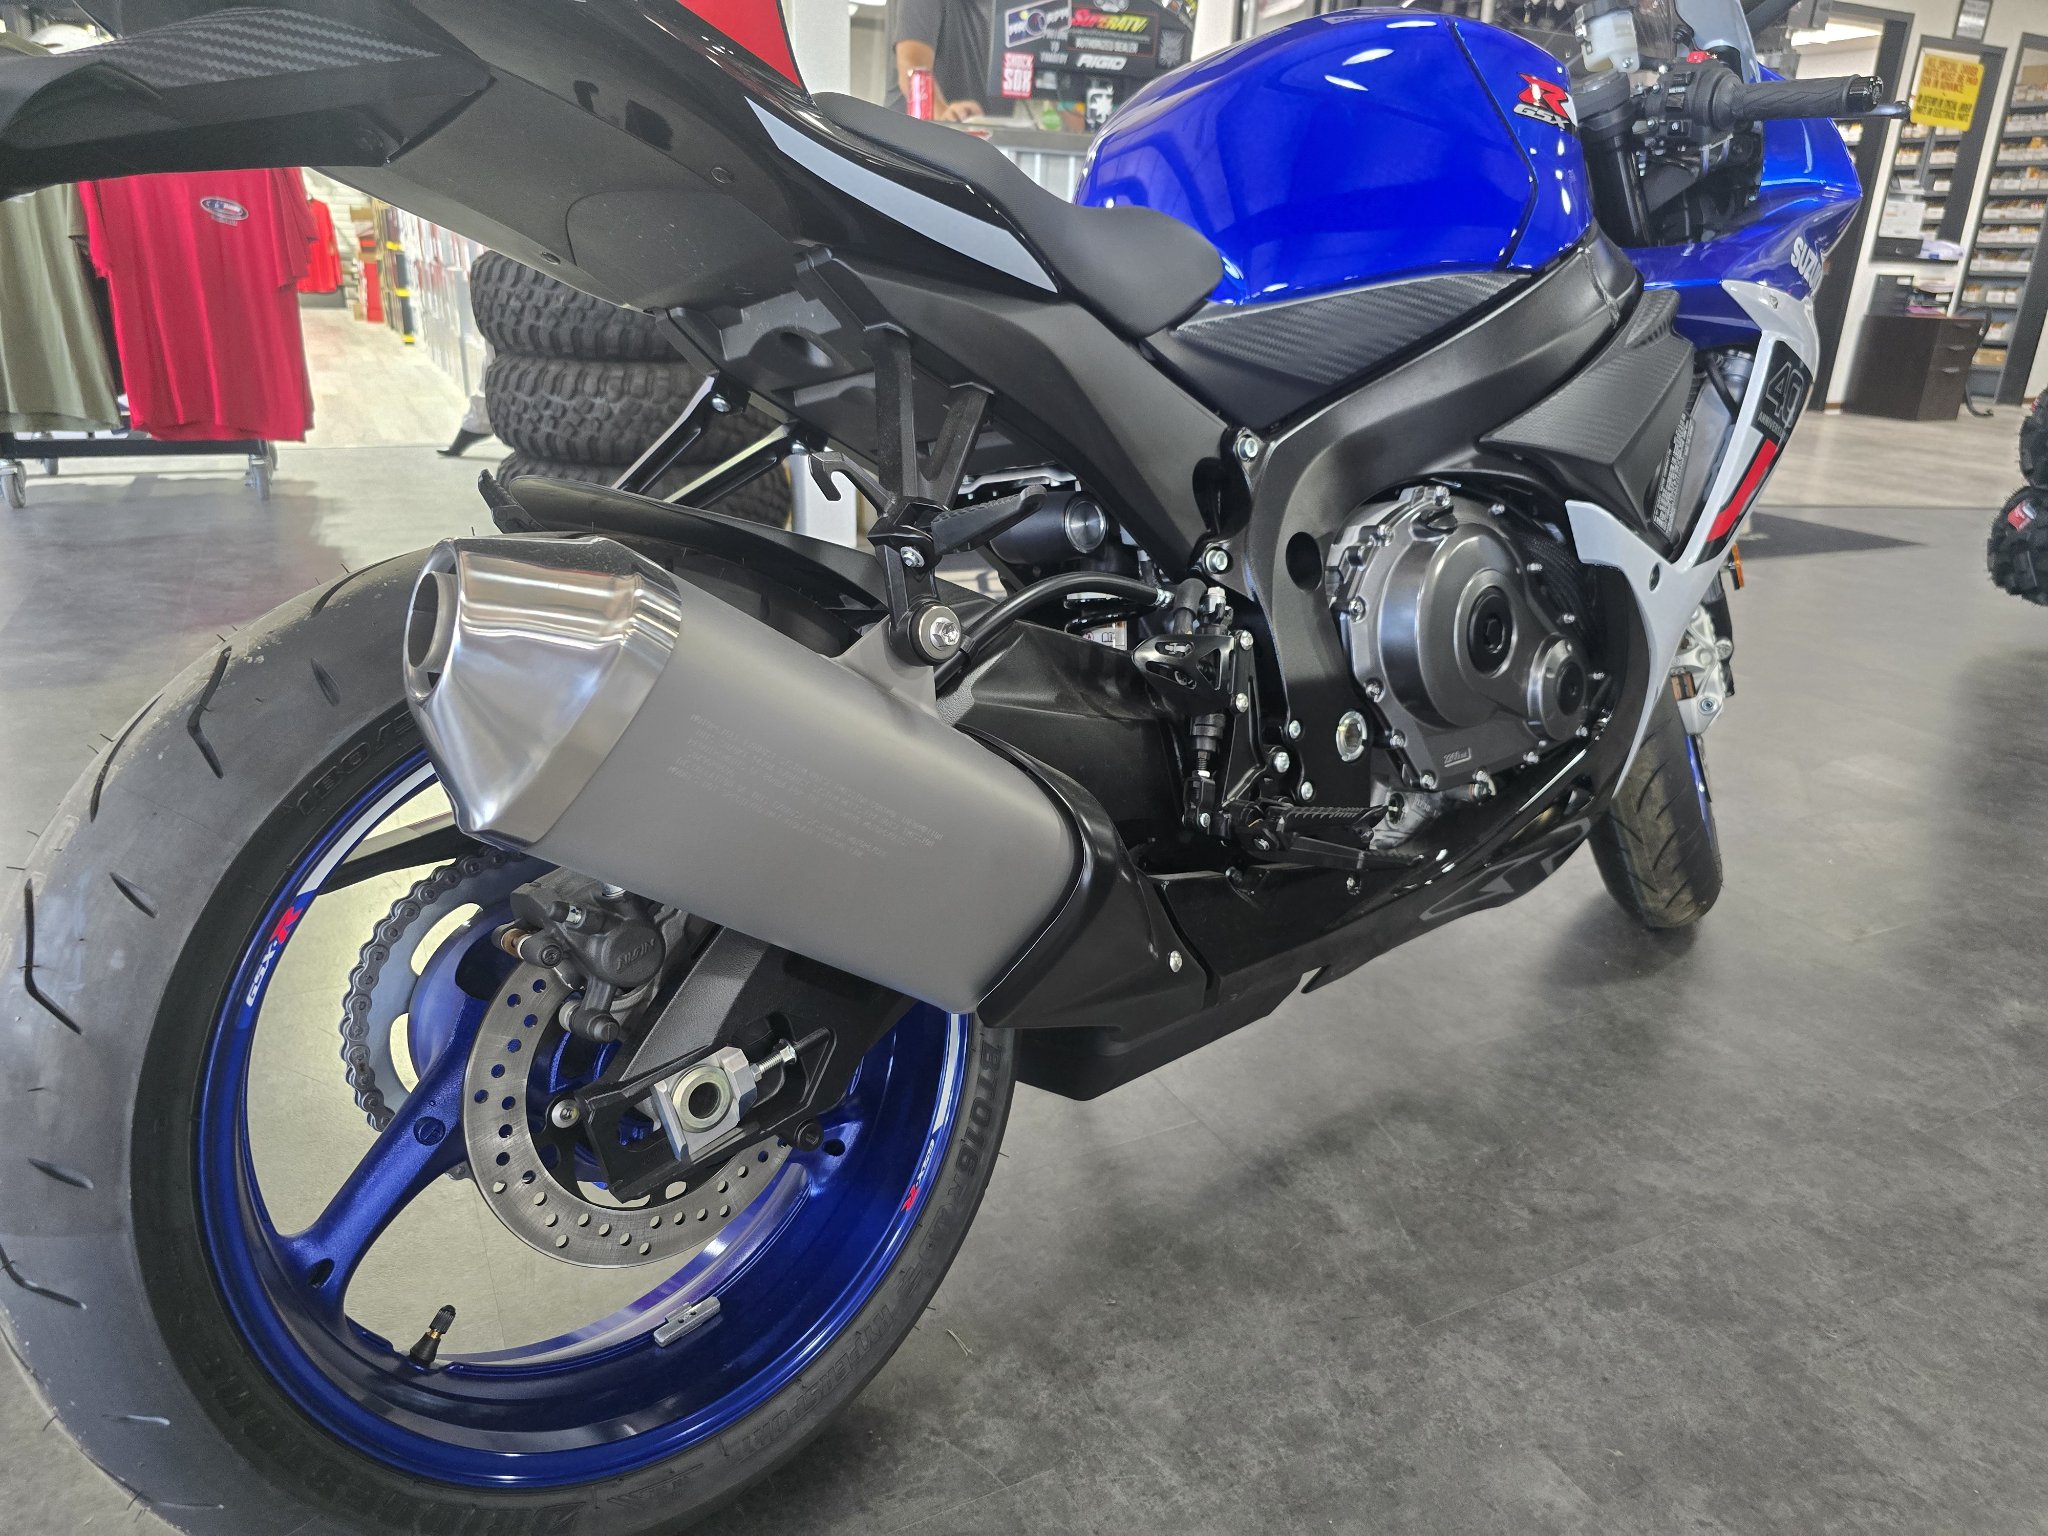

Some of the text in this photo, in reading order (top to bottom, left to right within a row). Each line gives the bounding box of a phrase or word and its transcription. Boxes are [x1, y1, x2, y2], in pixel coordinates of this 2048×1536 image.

[1076, 54, 1127, 70] RIGID
[1003, 69, 1032, 92] SOX
[1765, 361, 1804, 429] 40
